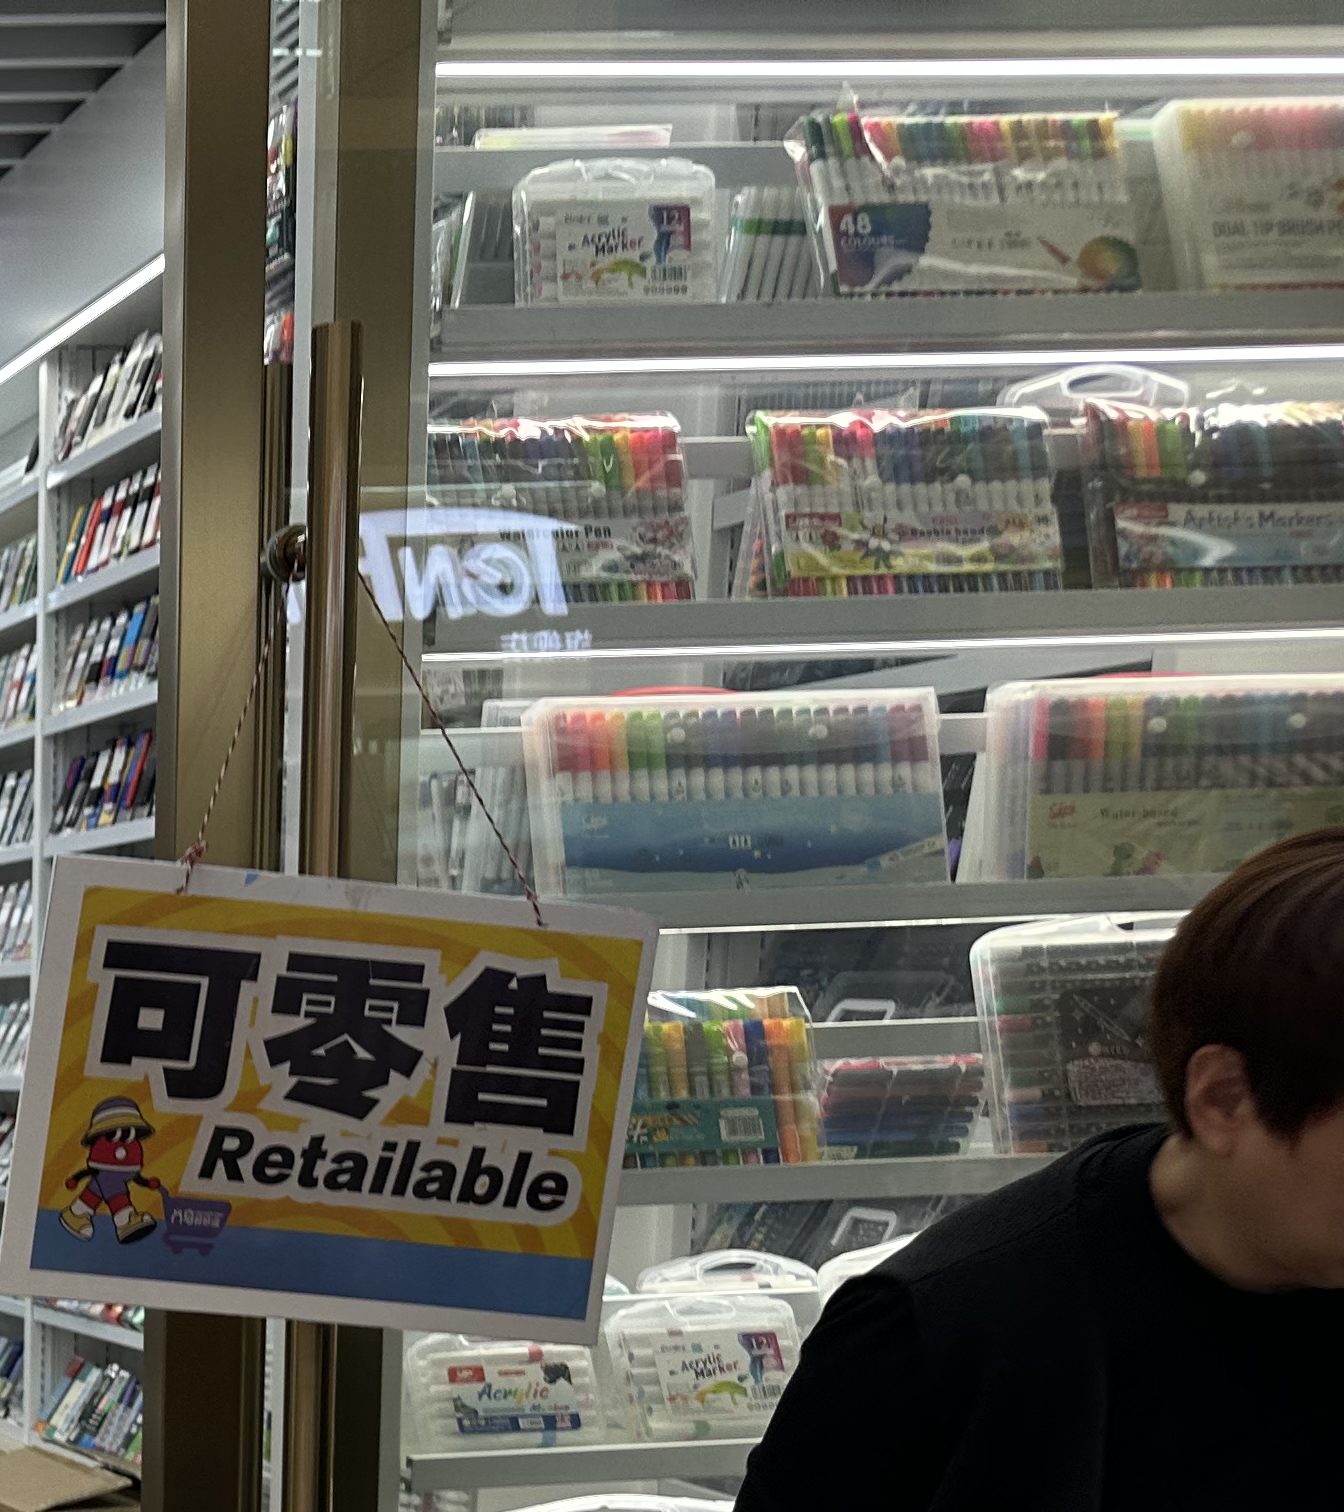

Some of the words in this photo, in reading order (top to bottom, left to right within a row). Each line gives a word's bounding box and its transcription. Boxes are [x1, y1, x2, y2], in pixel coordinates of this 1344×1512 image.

[100, 940, 594, 1136] 可零售
[197, 1125, 569, 1211] Retailable
